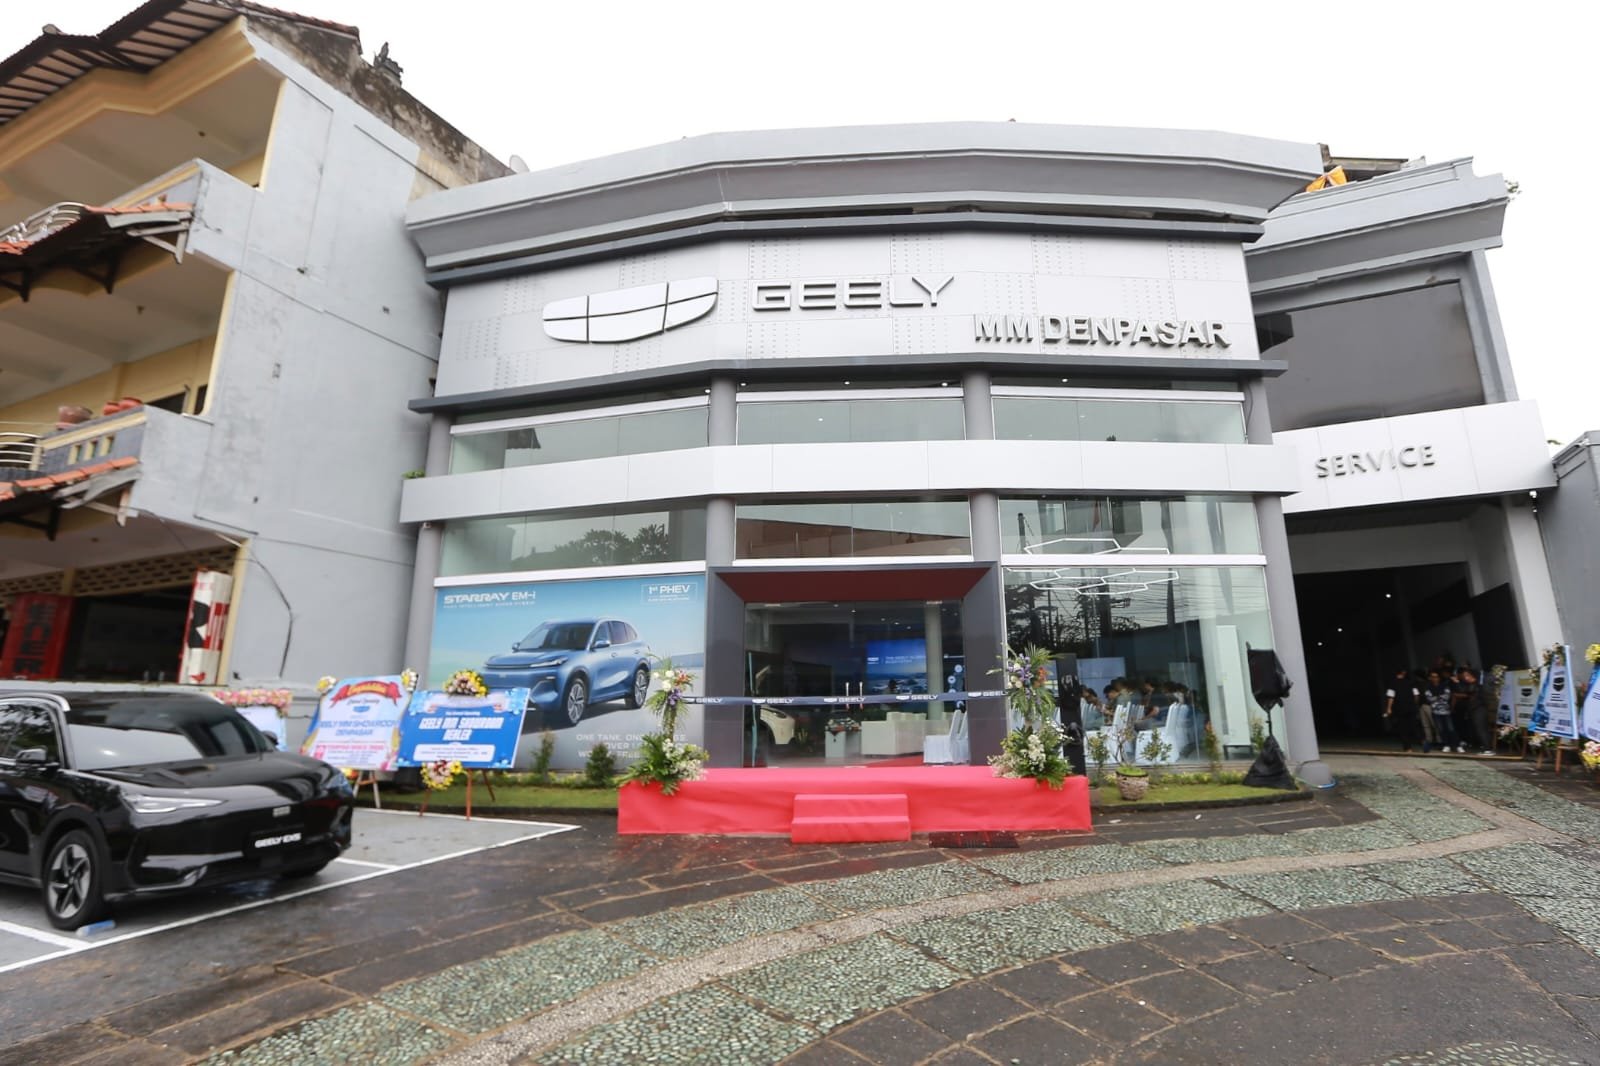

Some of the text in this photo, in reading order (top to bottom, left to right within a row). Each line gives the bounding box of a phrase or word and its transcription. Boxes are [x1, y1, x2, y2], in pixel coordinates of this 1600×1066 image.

[752, 274, 955, 313] GEELY
[974, 314, 1232, 349] MM DENPASAR
[1315, 446, 1436, 479] SERVICE
[443, 592, 510, 605] STARRAY
[660, 584, 690, 594] PHEV
